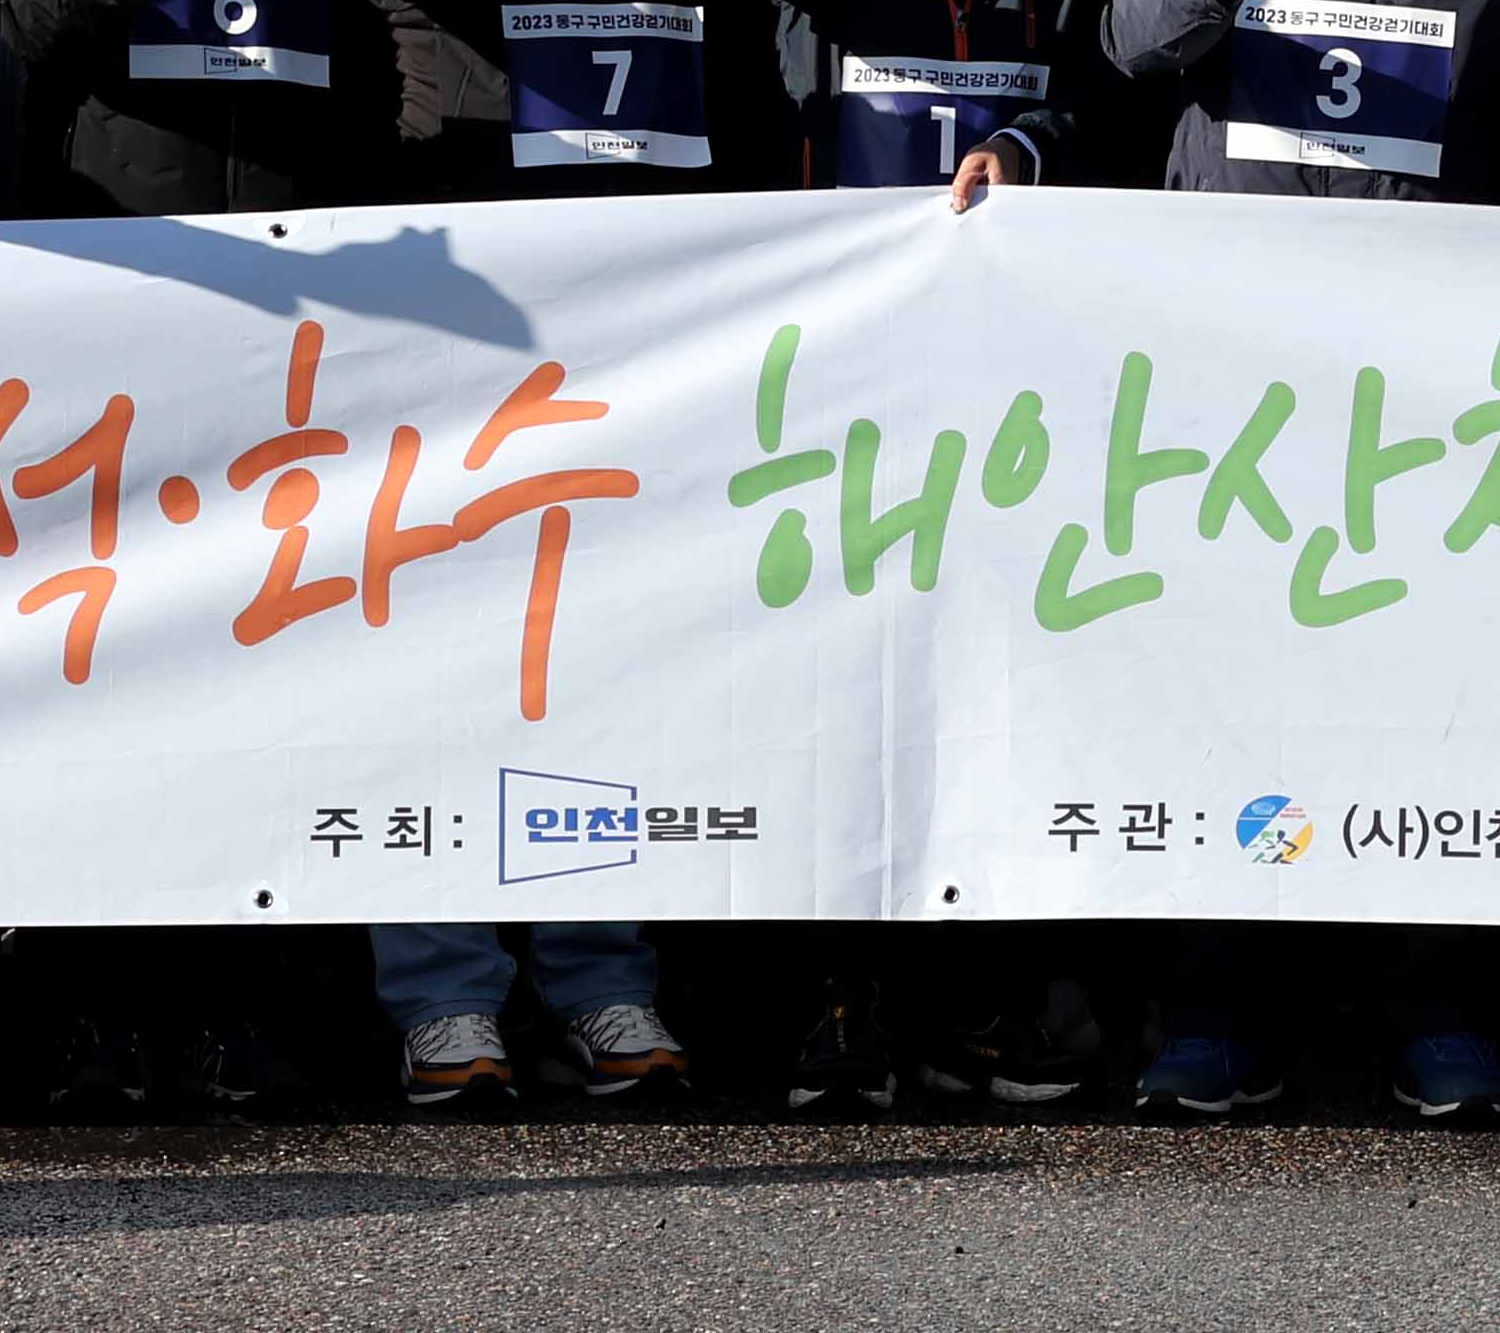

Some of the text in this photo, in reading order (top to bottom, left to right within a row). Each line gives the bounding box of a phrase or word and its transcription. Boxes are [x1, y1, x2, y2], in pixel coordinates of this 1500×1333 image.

[512, 13, 554, 31] 2023
[1244, 5, 1445, 39] 2023 동구 구민건강걷기대회
[591, 49, 633, 116] 7
[854, 67, 890, 84] 2023
[1315, 47, 1363, 119] 3
[930, 105, 957, 174] 1
[525, 804, 760, 844] 인천일보
